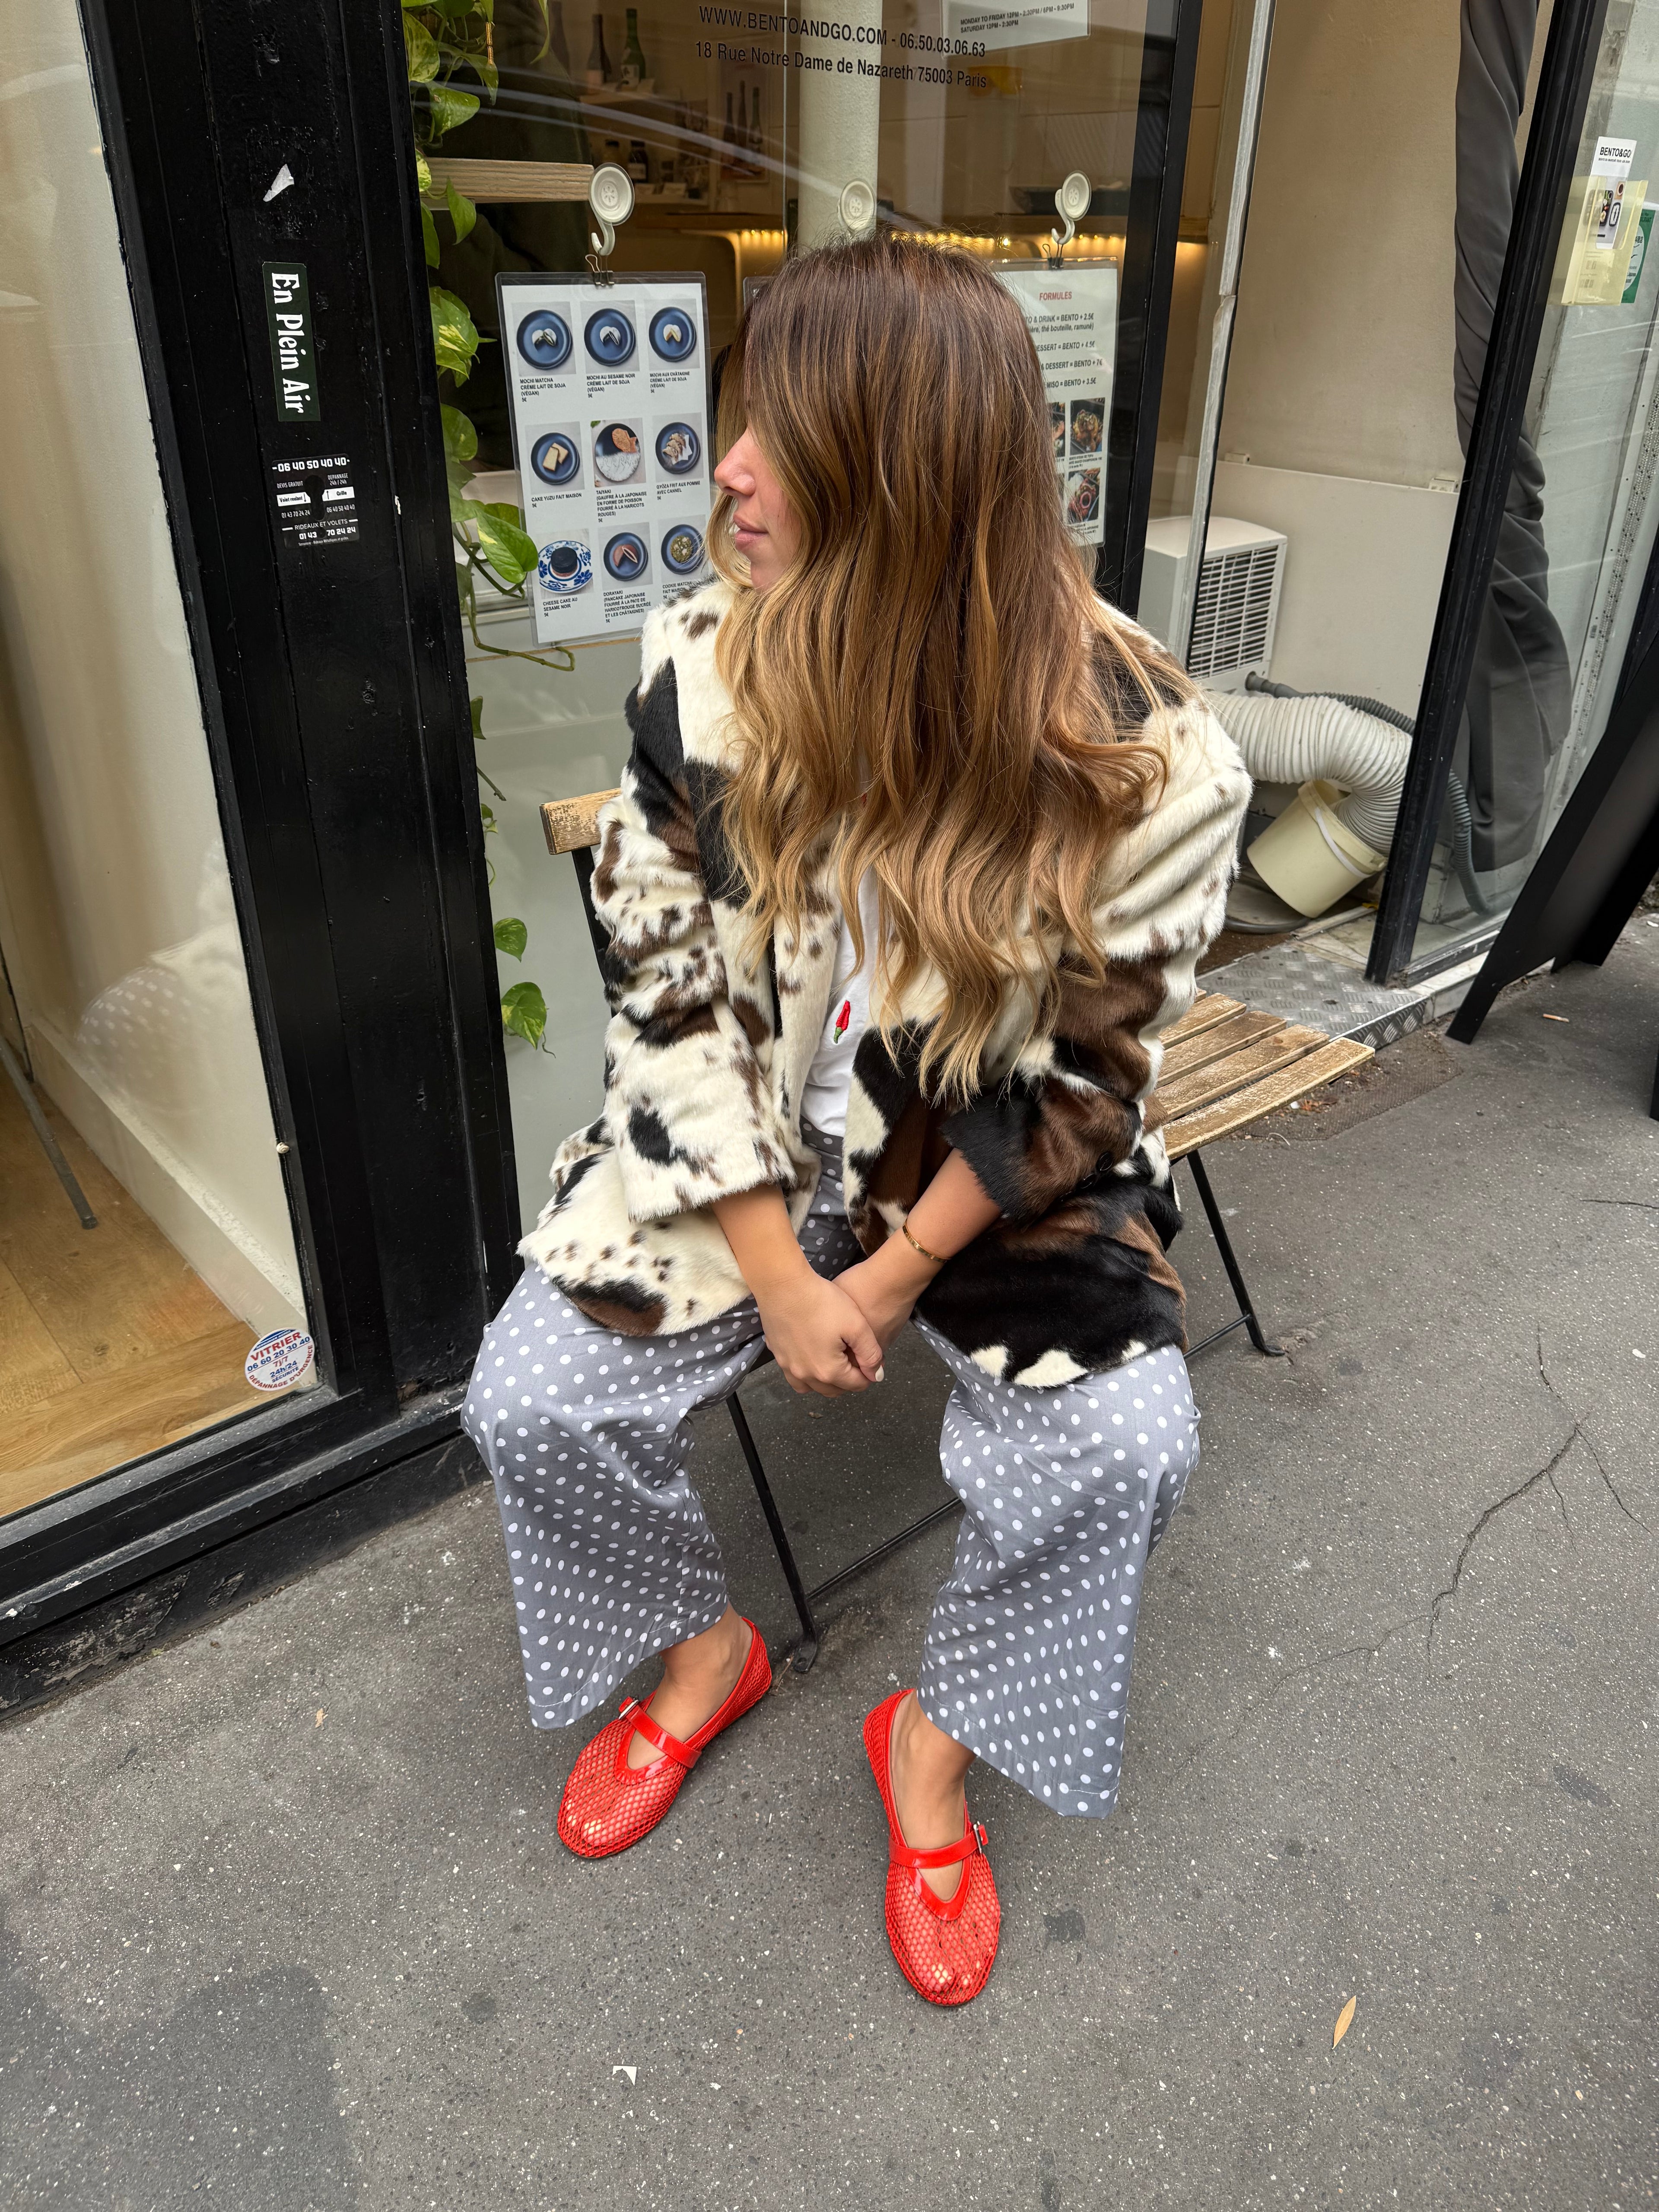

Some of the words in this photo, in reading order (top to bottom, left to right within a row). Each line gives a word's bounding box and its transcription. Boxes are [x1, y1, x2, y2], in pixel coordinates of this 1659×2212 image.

[699, 6, 887, 45] WWW.BENTOANDGO.COM
[900, 33, 985, 57] 06.50.03.06.63
[960, 25, 985, 33] SATURDAY
[696, 41, 712, 58] 18
[718, 43, 746, 61] Rue
[751, 47, 789, 66] Notre
[795, 52, 833, 71] Dame
[837, 57, 853, 73] de
[858, 59, 913, 80] Nazareth
[918, 67, 952, 84] 75003
[957, 71, 986, 88] Paris
[271, 273, 300, 304] En
[1039, 291, 1072, 301] FORMULES
[276, 313, 307, 370] Plein
[1036, 343, 1057, 352] ESSERT
[1062, 342, 1080, 350] BENTO
[1046, 361, 1069, 370] DESSERT
[282, 377, 311, 413] Air
[292, 461, 305, 470] 40
[306, 460, 319, 469] 50
[321, 458, 333, 467] 40
[248, 1363, 258, 1372] 06
[261, 1356, 271, 1365] 60
[273, 1350, 284, 1359] 20
[286, 1343, 297, 1351] 30
[299, 1336, 310, 1345] 40
[250, 1332, 302, 1361] VITRIER
[270, 1360, 297, 1378] 24h/24
[249, 1375, 288, 1389] DÉPANNAGE
